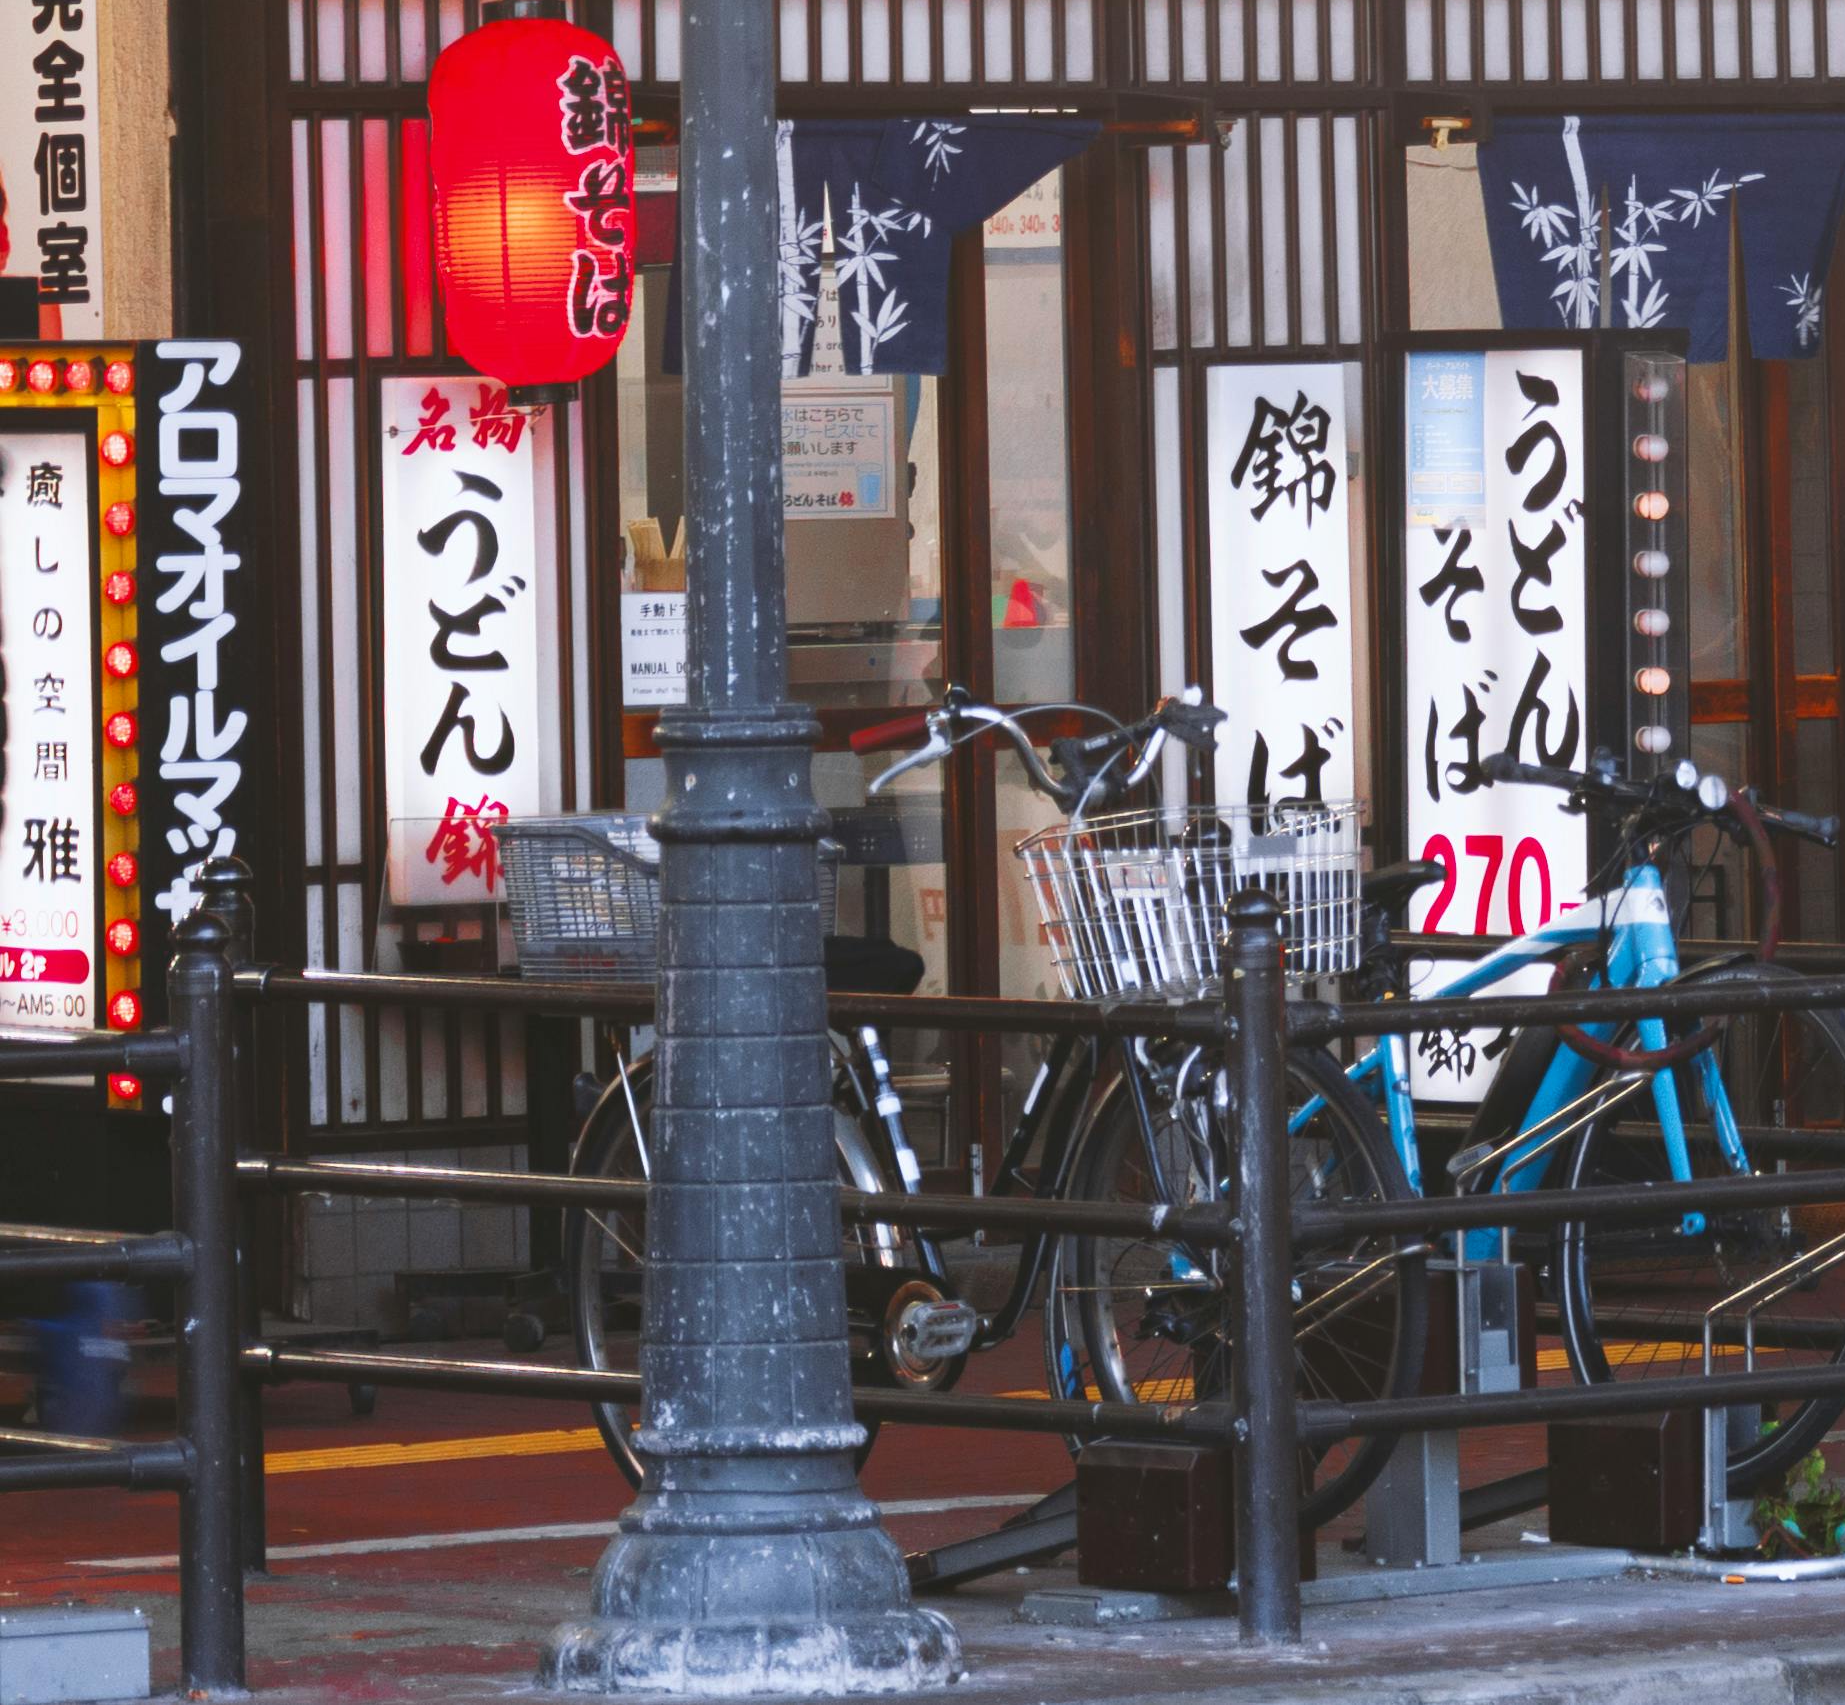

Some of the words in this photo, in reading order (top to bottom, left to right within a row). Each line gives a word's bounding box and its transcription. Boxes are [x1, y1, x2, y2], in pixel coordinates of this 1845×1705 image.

[402, 386, 528, 456] 名物
[25, 461, 69, 785] 癒しの空間
[418, 469, 527, 779] うどん
[1419, 517, 1499, 802] そば
[1506, 370, 1585, 770] うどん
[631, 662, 669, 675] MANUAL
[23, 816, 81, 885] 雅
[1421, 834, 1584, 935] 270
